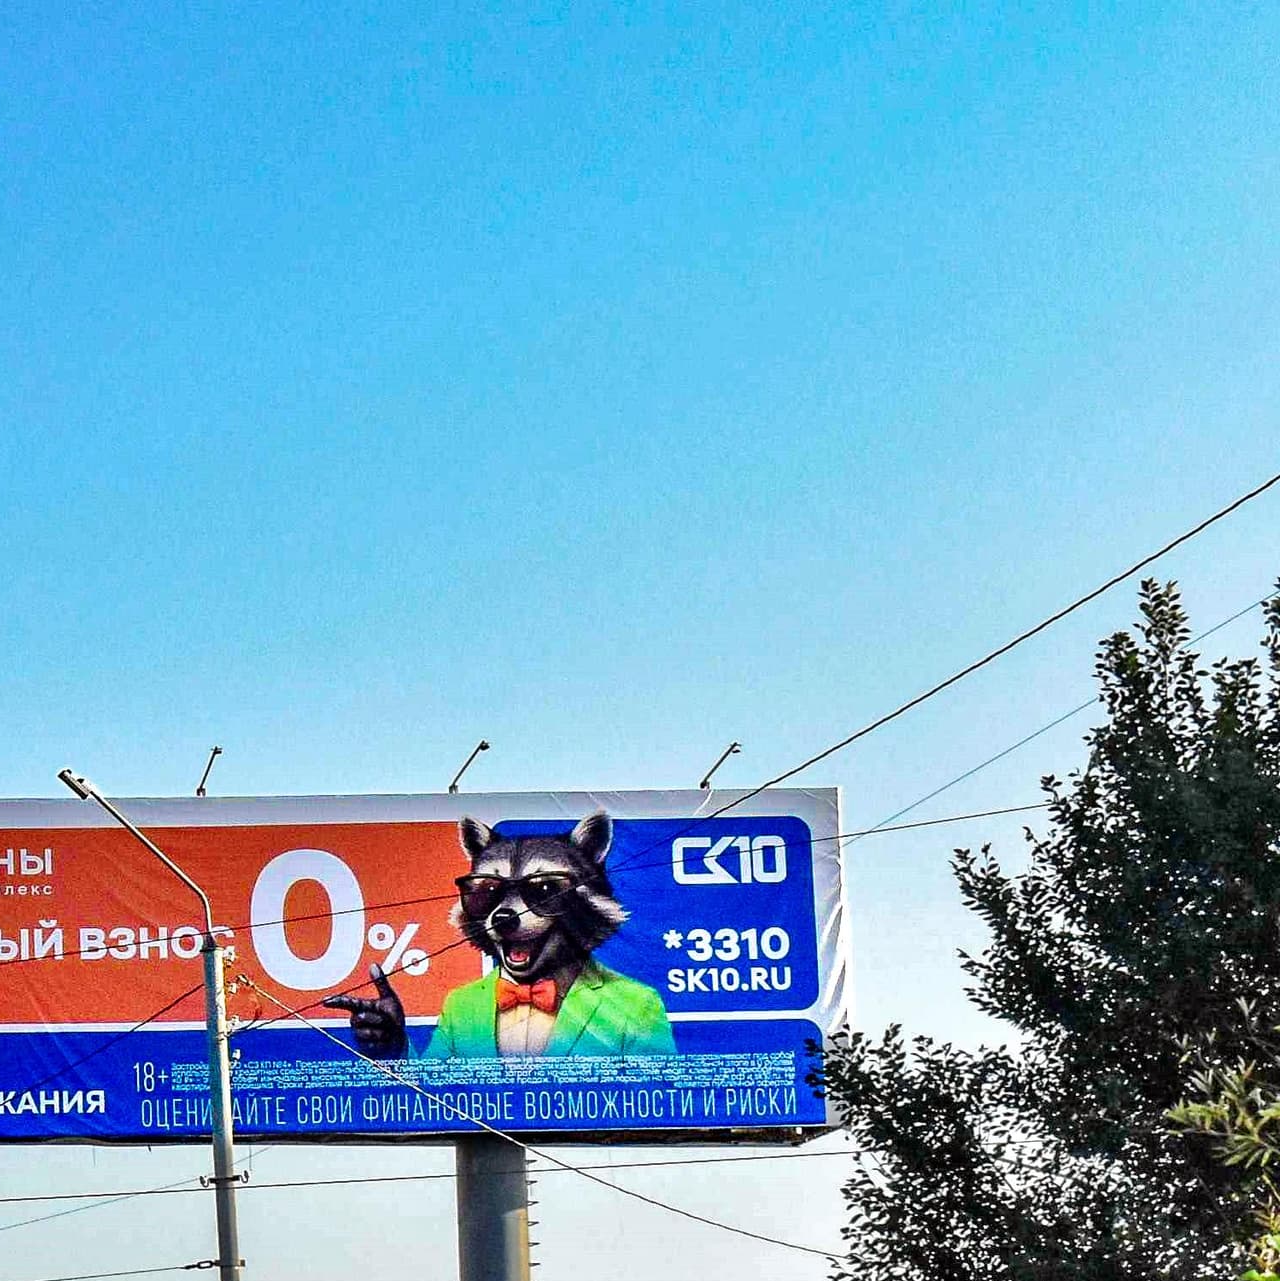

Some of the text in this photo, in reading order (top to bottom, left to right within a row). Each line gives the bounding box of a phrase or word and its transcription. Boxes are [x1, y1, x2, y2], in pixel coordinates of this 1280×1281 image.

[667, 966, 791, 993] SK10.RU
[133, 1062, 169, 1092] 18+
[142, 1087, 797, 1130] ОЦЕНИАЙТЕ СВОИ ФИНАНСОВЫЕ ВОЗМОЖНОСТИ И РИСКИ
